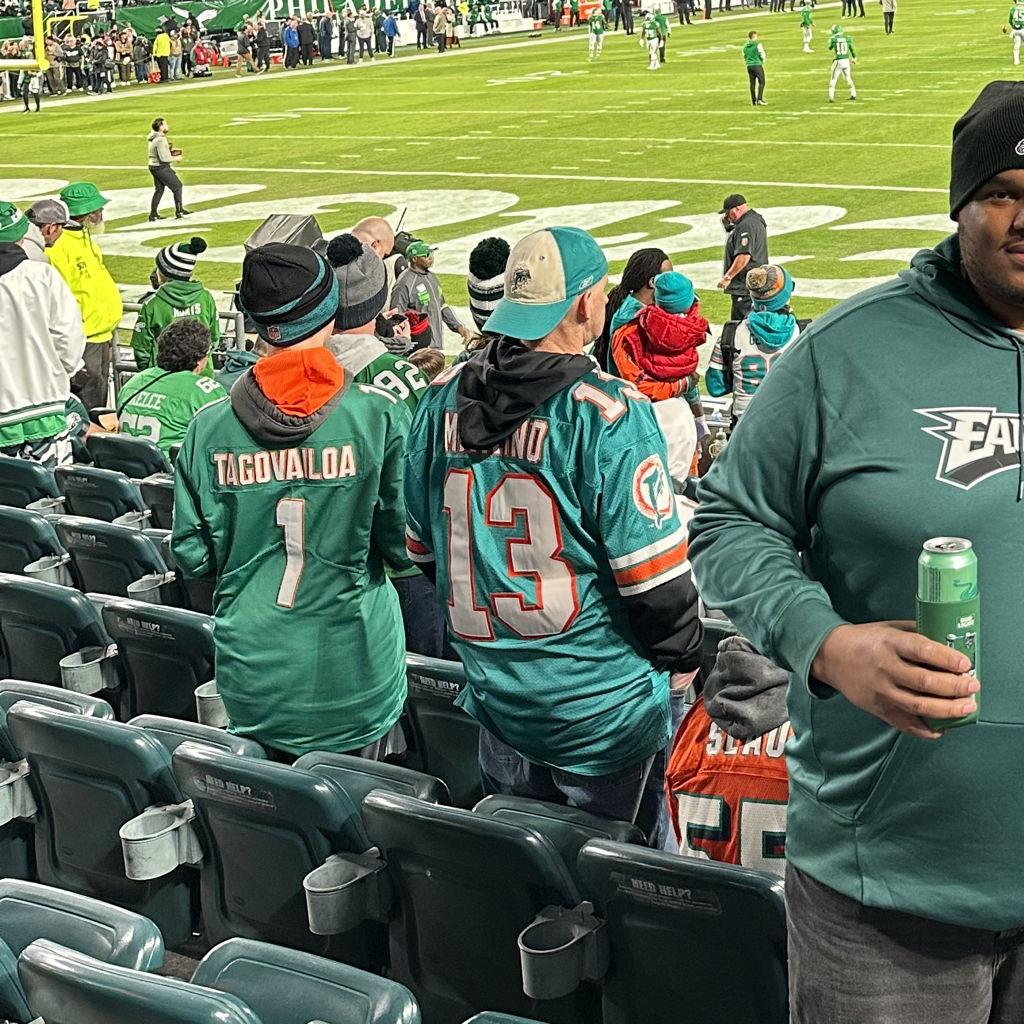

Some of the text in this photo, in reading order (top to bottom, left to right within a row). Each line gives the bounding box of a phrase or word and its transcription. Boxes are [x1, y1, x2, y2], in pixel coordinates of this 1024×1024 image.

[213, 444, 358, 487] TAGOVAILOA
[275, 496, 306, 608] 1
[443, 467, 581, 641] 13
[631, 878, 657, 892] NEED
[658, 884, 692, 899] HELP?
